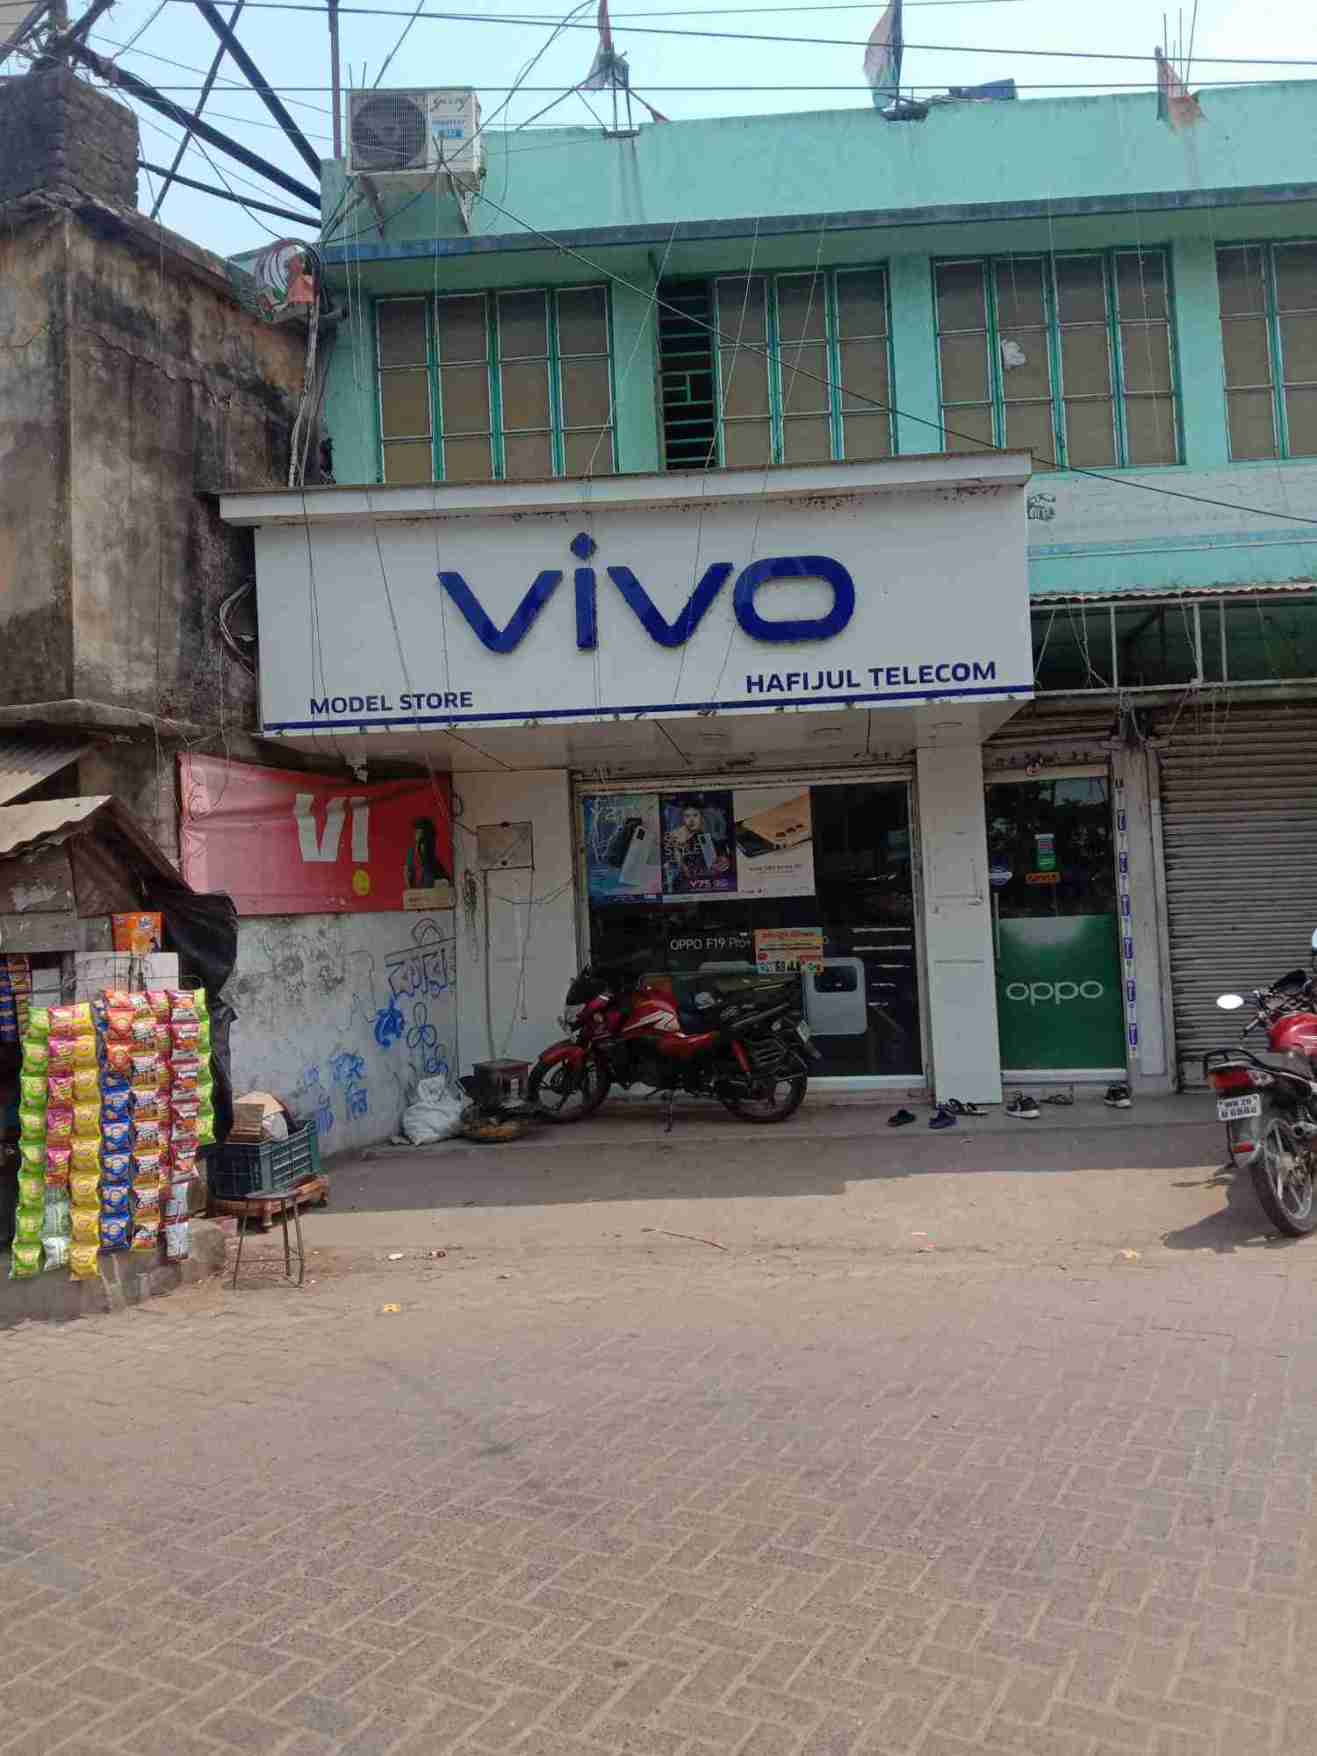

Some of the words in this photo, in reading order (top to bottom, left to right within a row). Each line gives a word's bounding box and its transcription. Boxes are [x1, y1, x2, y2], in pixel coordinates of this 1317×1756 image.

[437, 532, 855, 655] vivo
[746, 668, 860, 694] HAFIJUL
[868, 661, 996, 688] TELECOM
[310, 696, 393, 715] MODEL
[399, 691, 473, 711] STORE
[670, 939, 702, 951] OPPO
[706, 938, 726, 950] F19
[1005, 980, 1104, 1006] oppo
